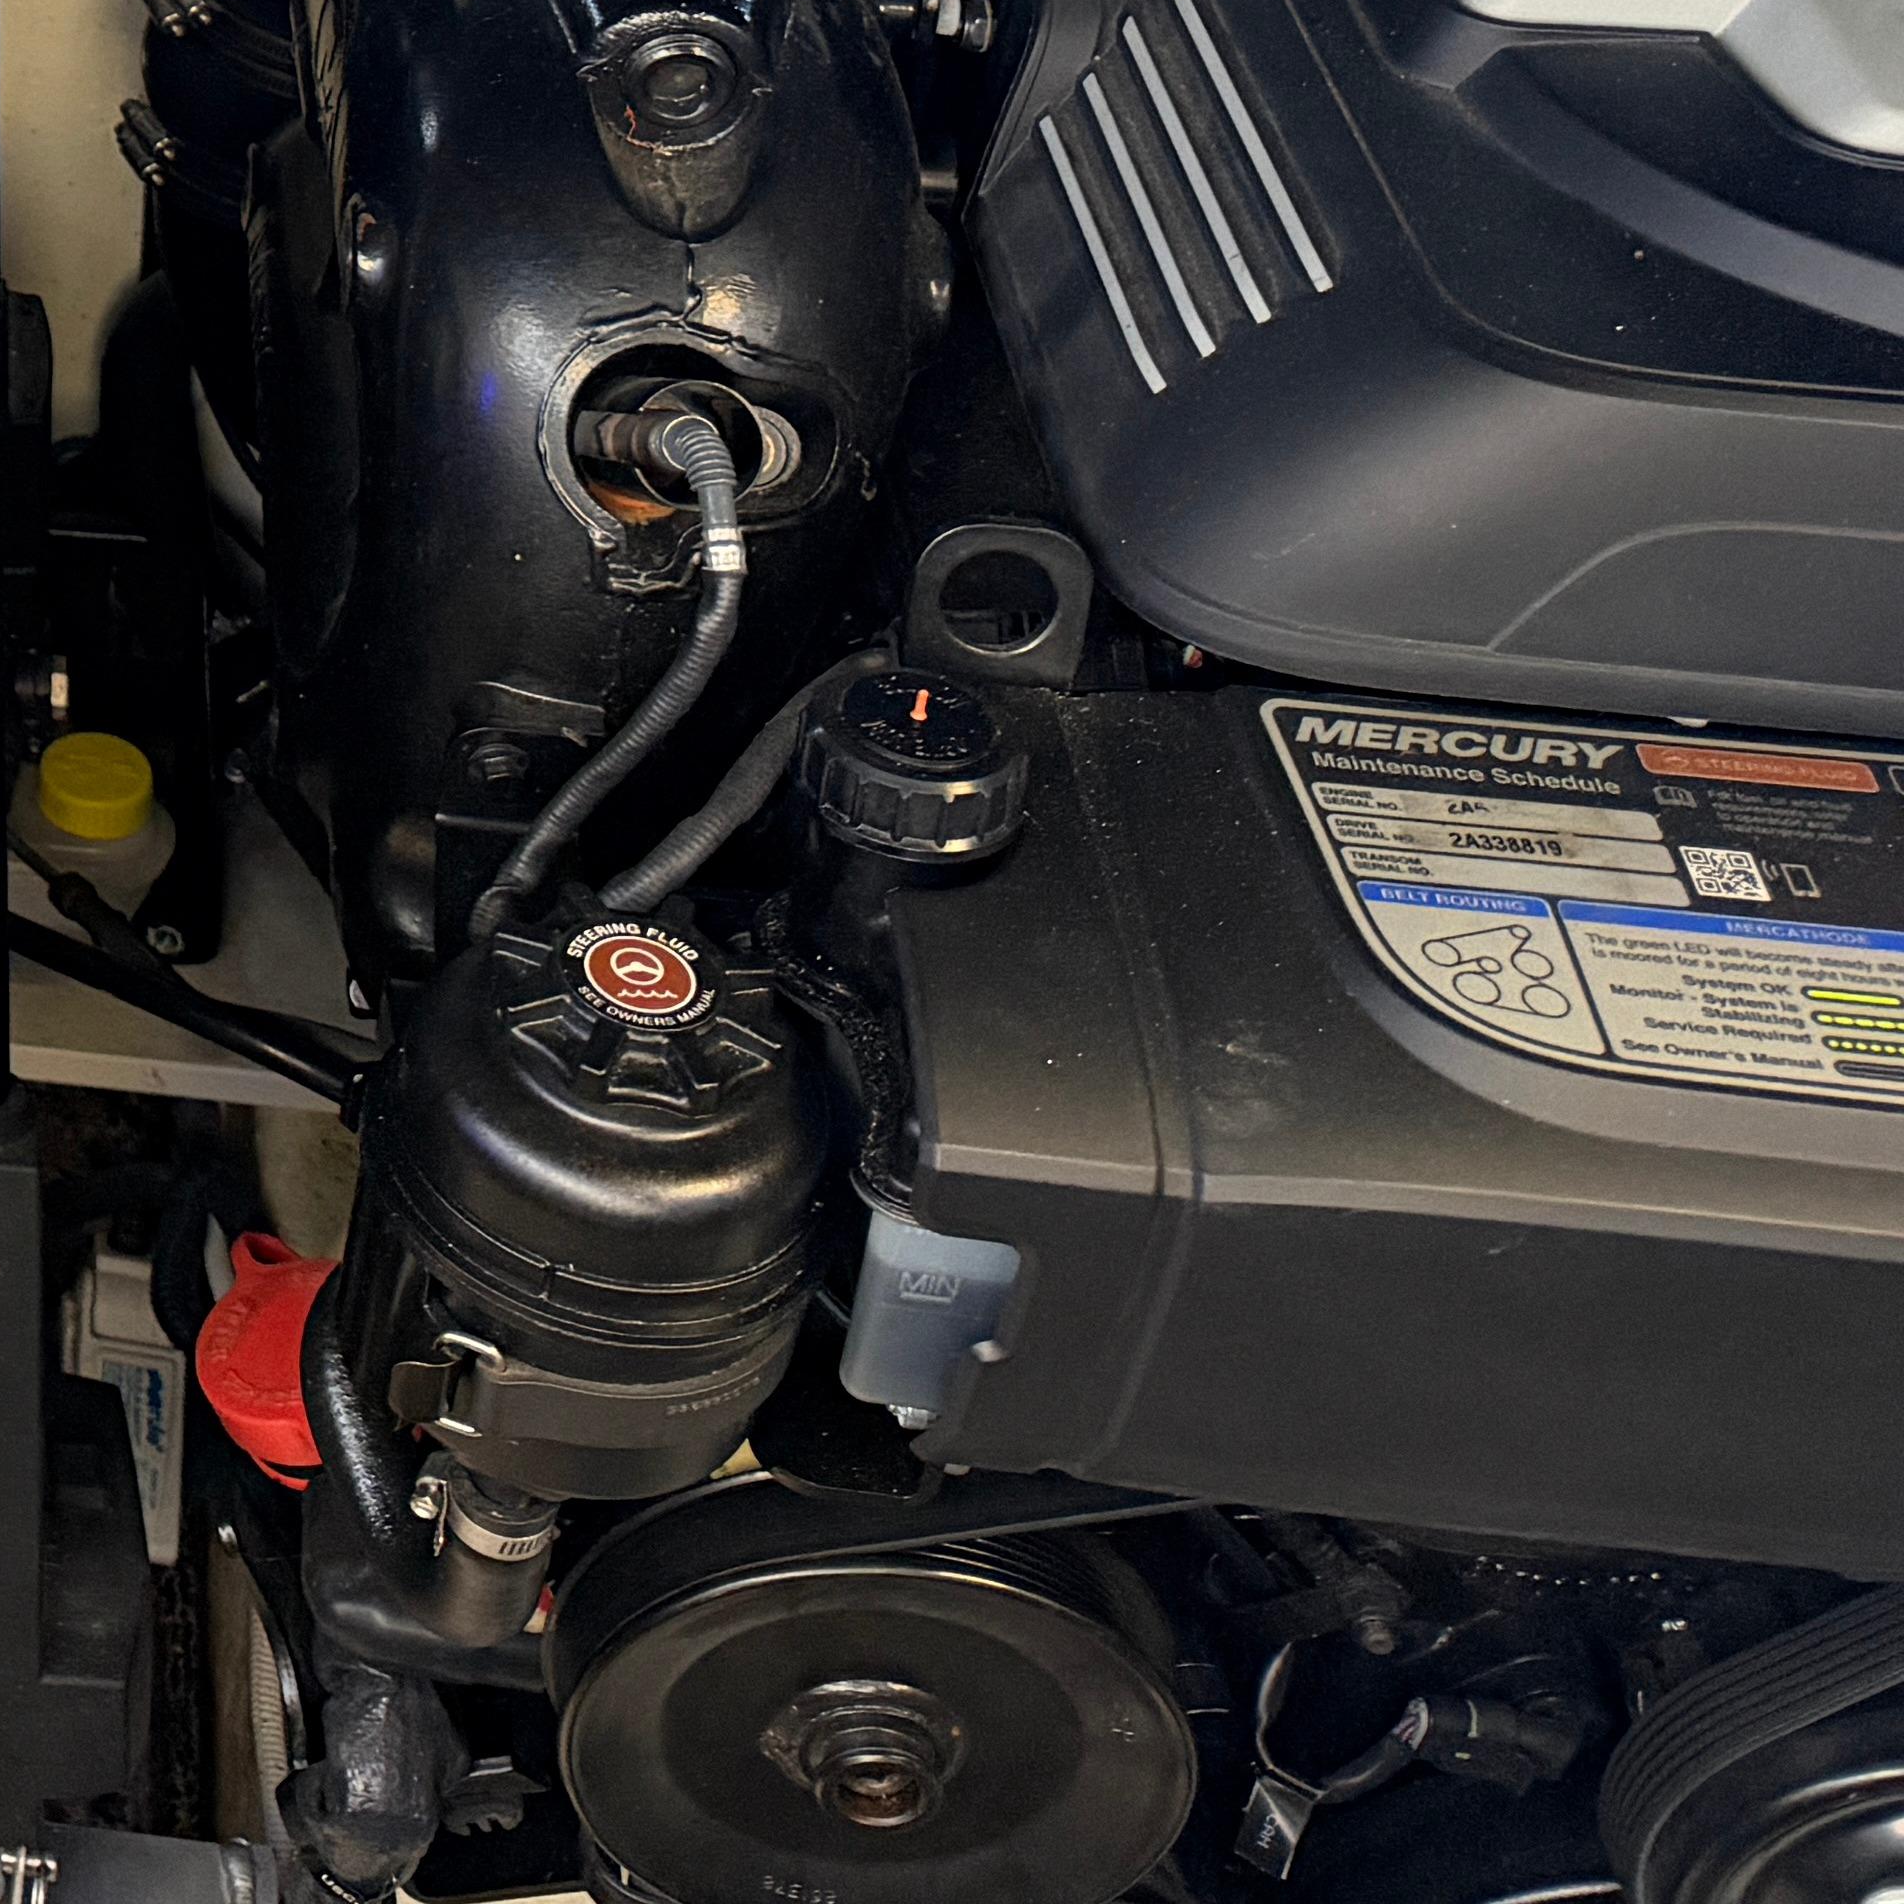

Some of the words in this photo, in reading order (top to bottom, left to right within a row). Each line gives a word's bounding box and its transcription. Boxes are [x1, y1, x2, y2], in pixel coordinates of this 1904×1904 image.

[1294, 715, 1624, 770] MERCURY
[1309, 750, 1487, 783] Maintenance
[1488, 766, 1622, 796] Schedule
[1447, 832, 1565, 858] 2A338819
[1378, 887, 1437, 903] BELT
[1440, 893, 1527, 913] ROUTING
[567, 922, 641, 958] STEERING
[646, 927, 699, 961] FLUID
[1724, 921, 1871, 944] MERCATHODE
[1680, 974, 1756, 993] System
[1759, 982, 1792, 995] OK
[578, 985, 604, 1007] SEE
[606, 1006, 676, 1026] OWNERS
[677, 988, 716, 1023] MANUAL
[1642, 1017, 1719, 1035] Service
[1721, 1025, 1813, 1045] Required
[899, 1271, 961, 1299] MIN
